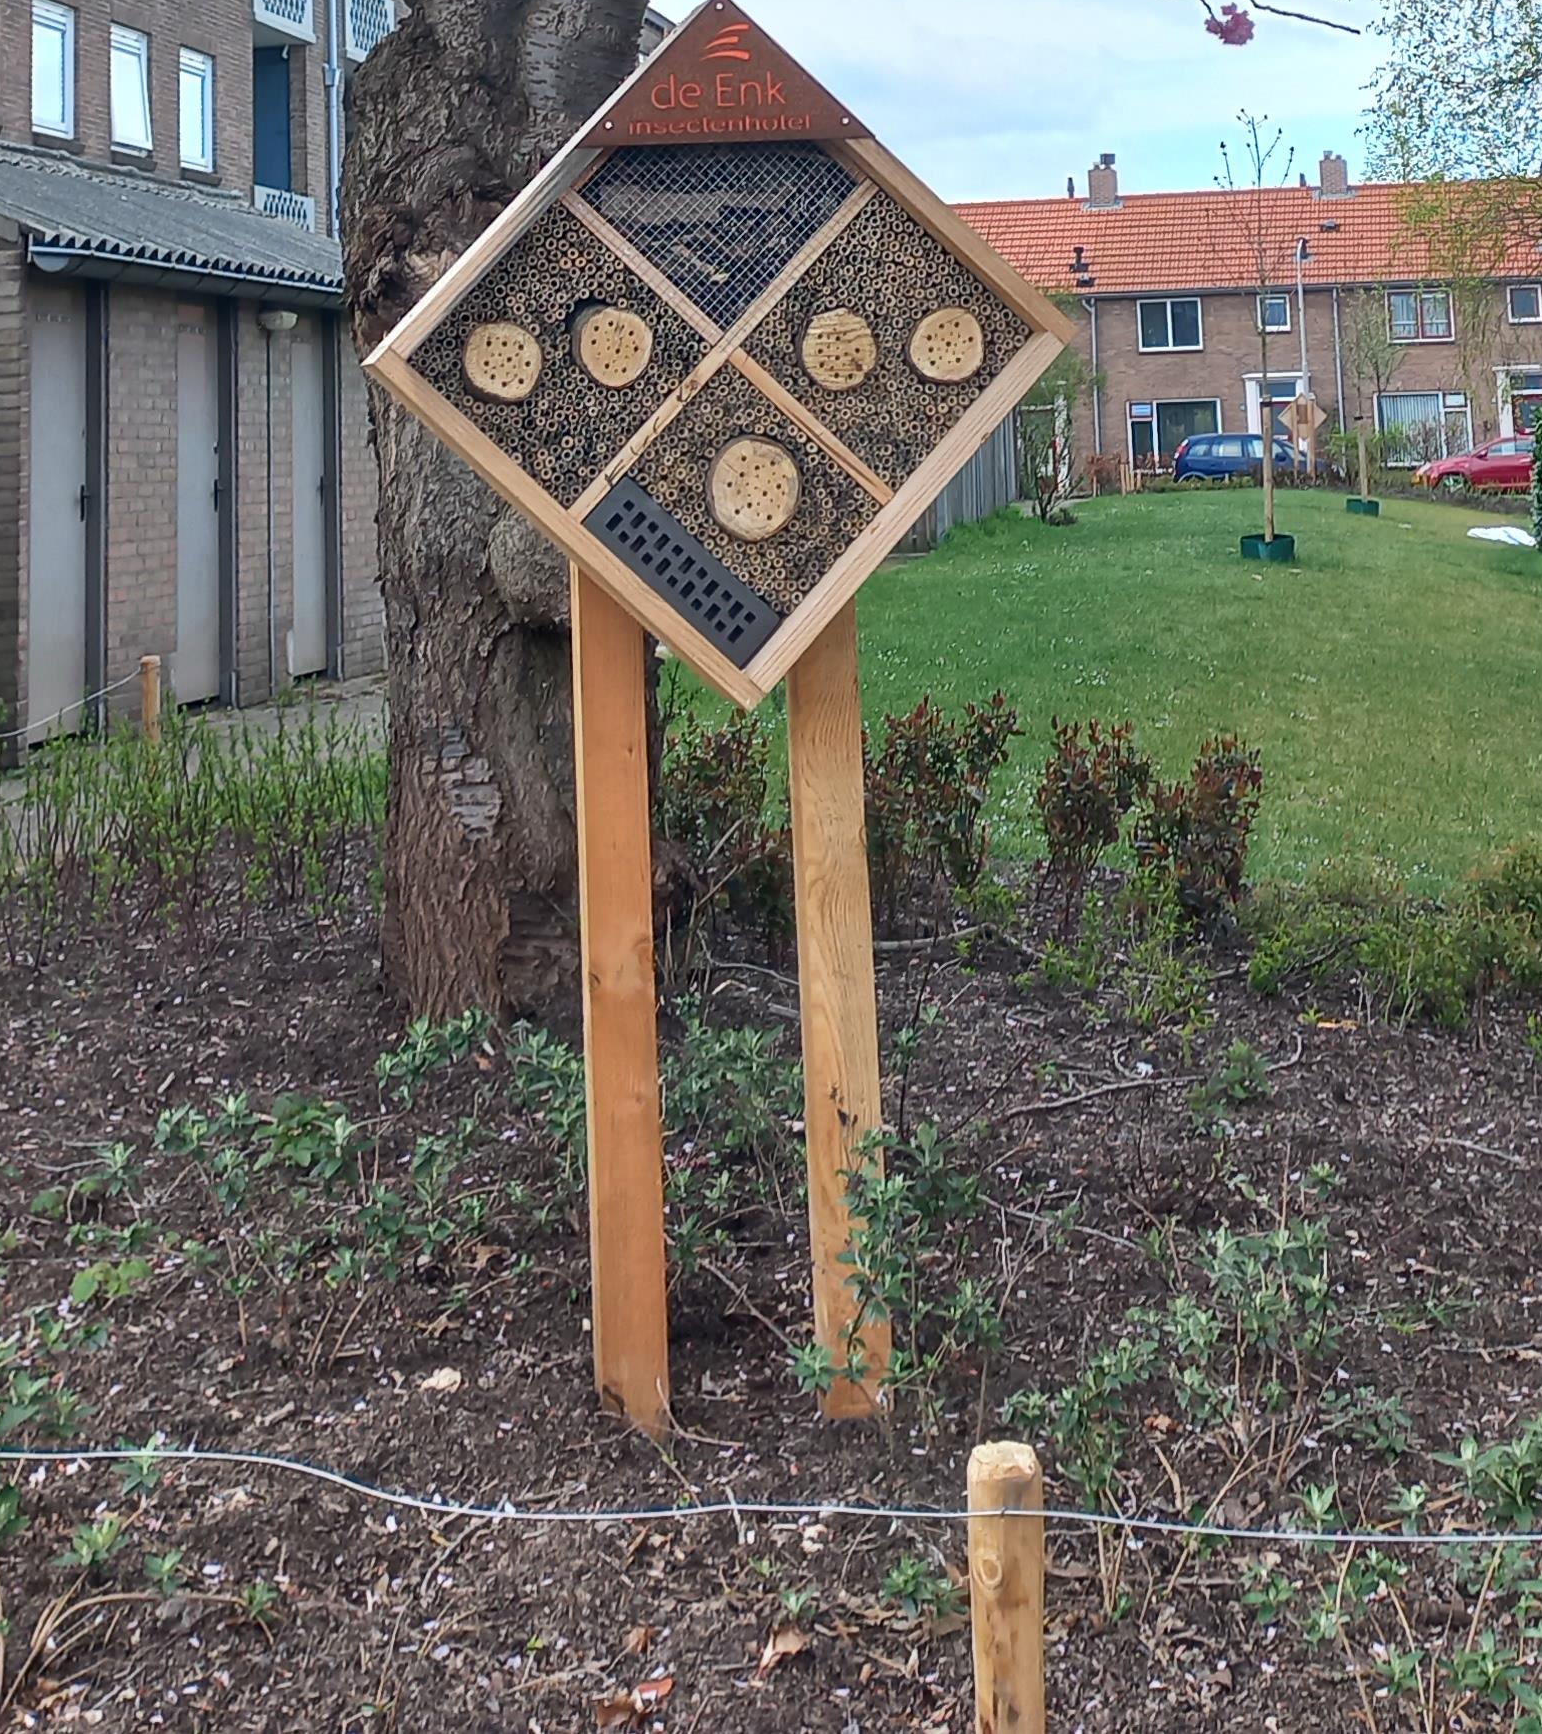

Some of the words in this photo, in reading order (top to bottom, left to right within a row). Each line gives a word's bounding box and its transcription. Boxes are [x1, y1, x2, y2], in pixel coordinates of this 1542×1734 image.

[650, 73, 702, 109] de
[715, 71, 787, 107] Enk
[629, 113, 811, 135] insectenhotel
